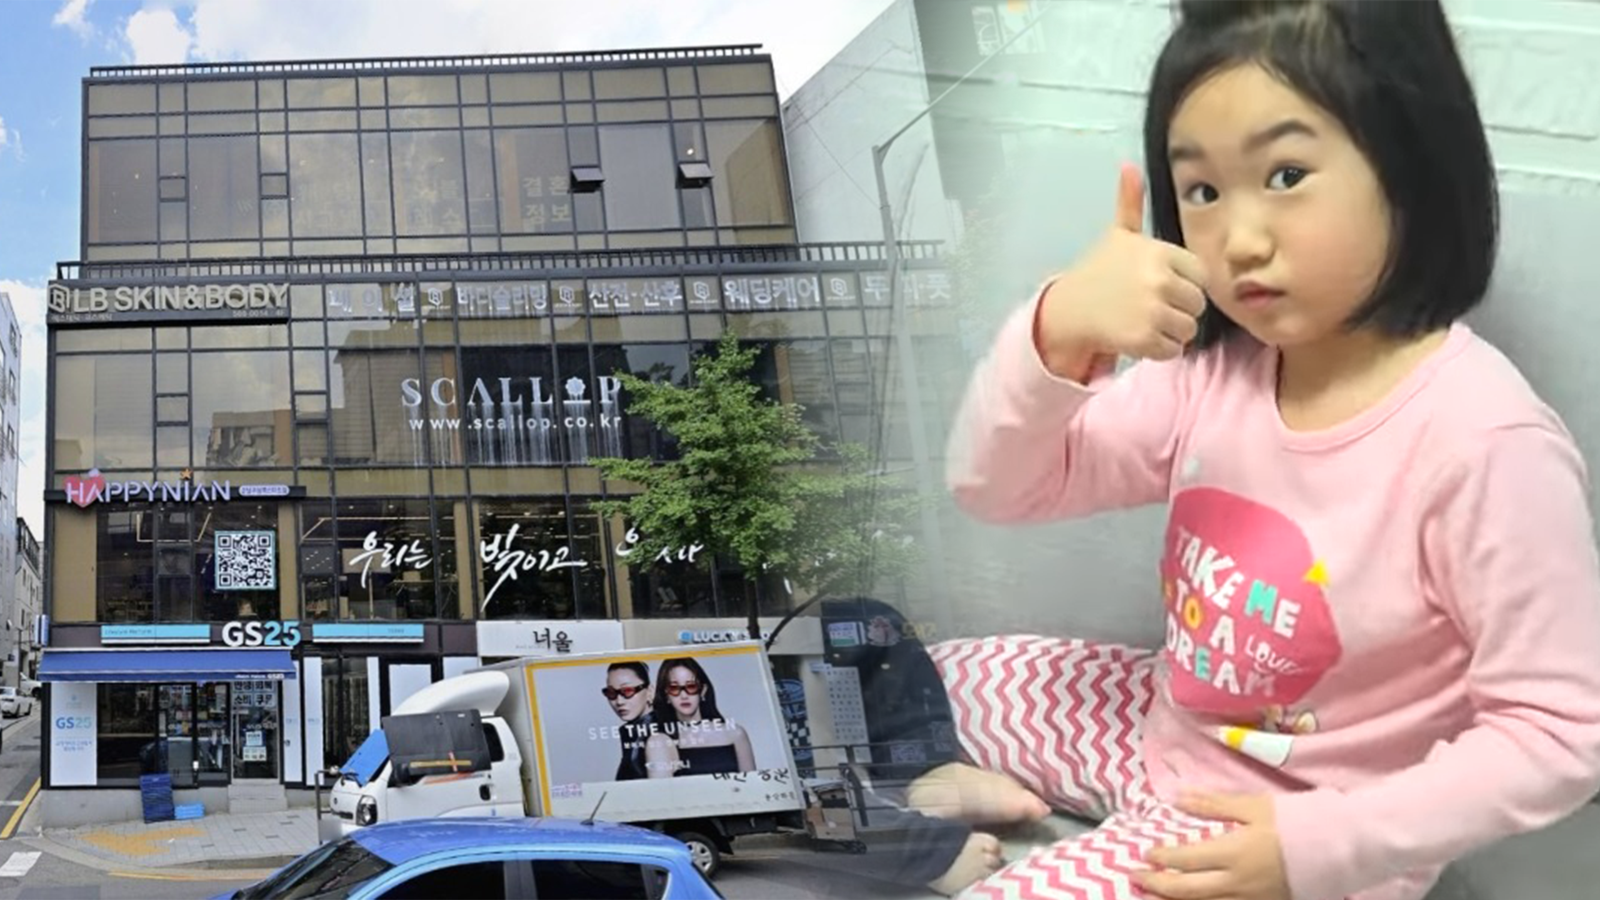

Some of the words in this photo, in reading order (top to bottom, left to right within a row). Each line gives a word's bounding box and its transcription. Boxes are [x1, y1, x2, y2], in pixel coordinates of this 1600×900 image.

[524, 204, 571, 225] 정보
[114, 283, 290, 311] SKIN&BODY
[724, 277, 820, 305] 웨딩케어
[66, 479, 231, 503] HAPPYNIAN
[1176, 526, 1245, 610] TAKE
[1245, 579, 1302, 639] ME
[1177, 578, 1202, 629] TO
[1210, 615, 1235, 655] A
[222, 620, 301, 648] GS25
[532, 627, 573, 653] 너울
[1167, 613, 1275, 697] DREAM
[56, 717, 92, 729] GS25
[588, 726, 620, 740] SEE
[625, 722, 661, 738] THE
[664, 717, 737, 735] UNSEEN
